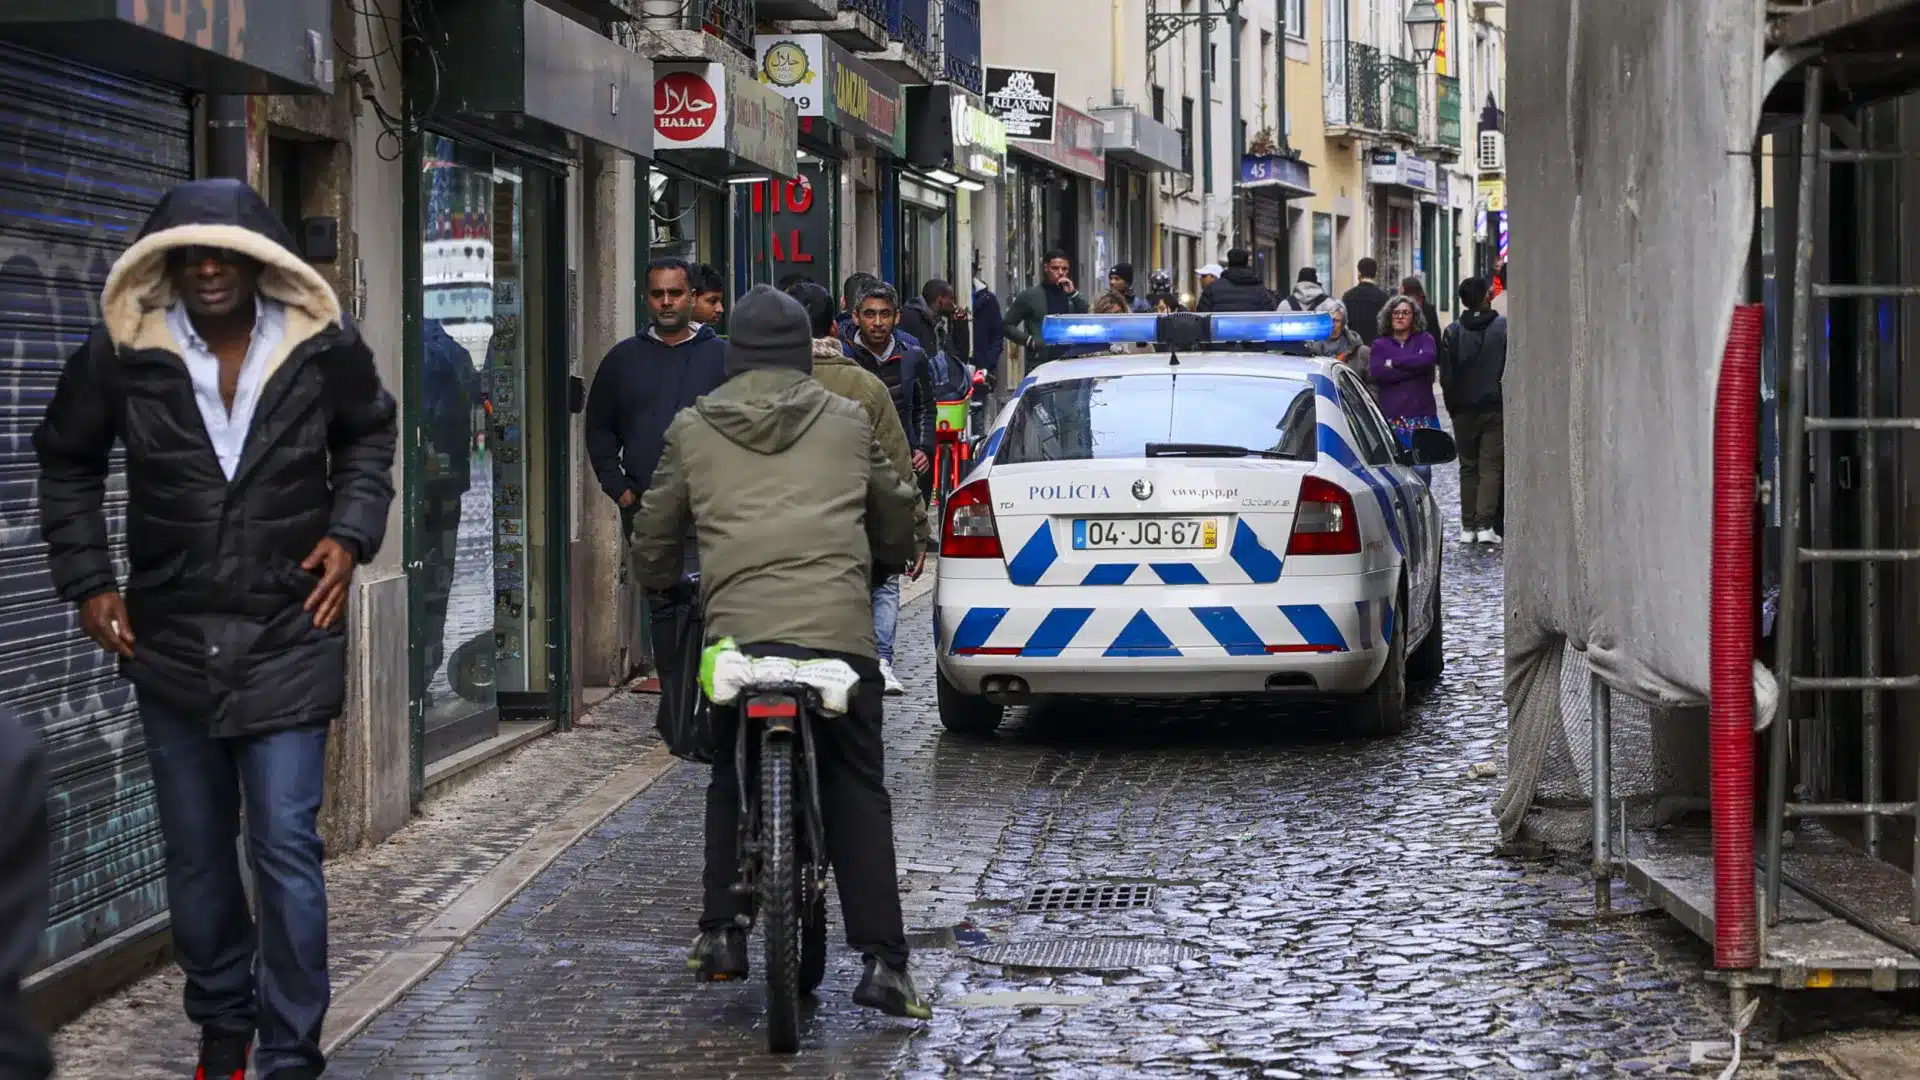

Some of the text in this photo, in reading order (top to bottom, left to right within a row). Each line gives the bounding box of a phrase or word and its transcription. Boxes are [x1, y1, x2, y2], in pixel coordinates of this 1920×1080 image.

[660, 117, 706, 128] HALAL
[1250, 163, 1266, 178] 45
[1028, 481, 1111, 500] POLÍCIA
[1077, 536, 1084, 544] P
[1205, 537, 1215, 545] 08
